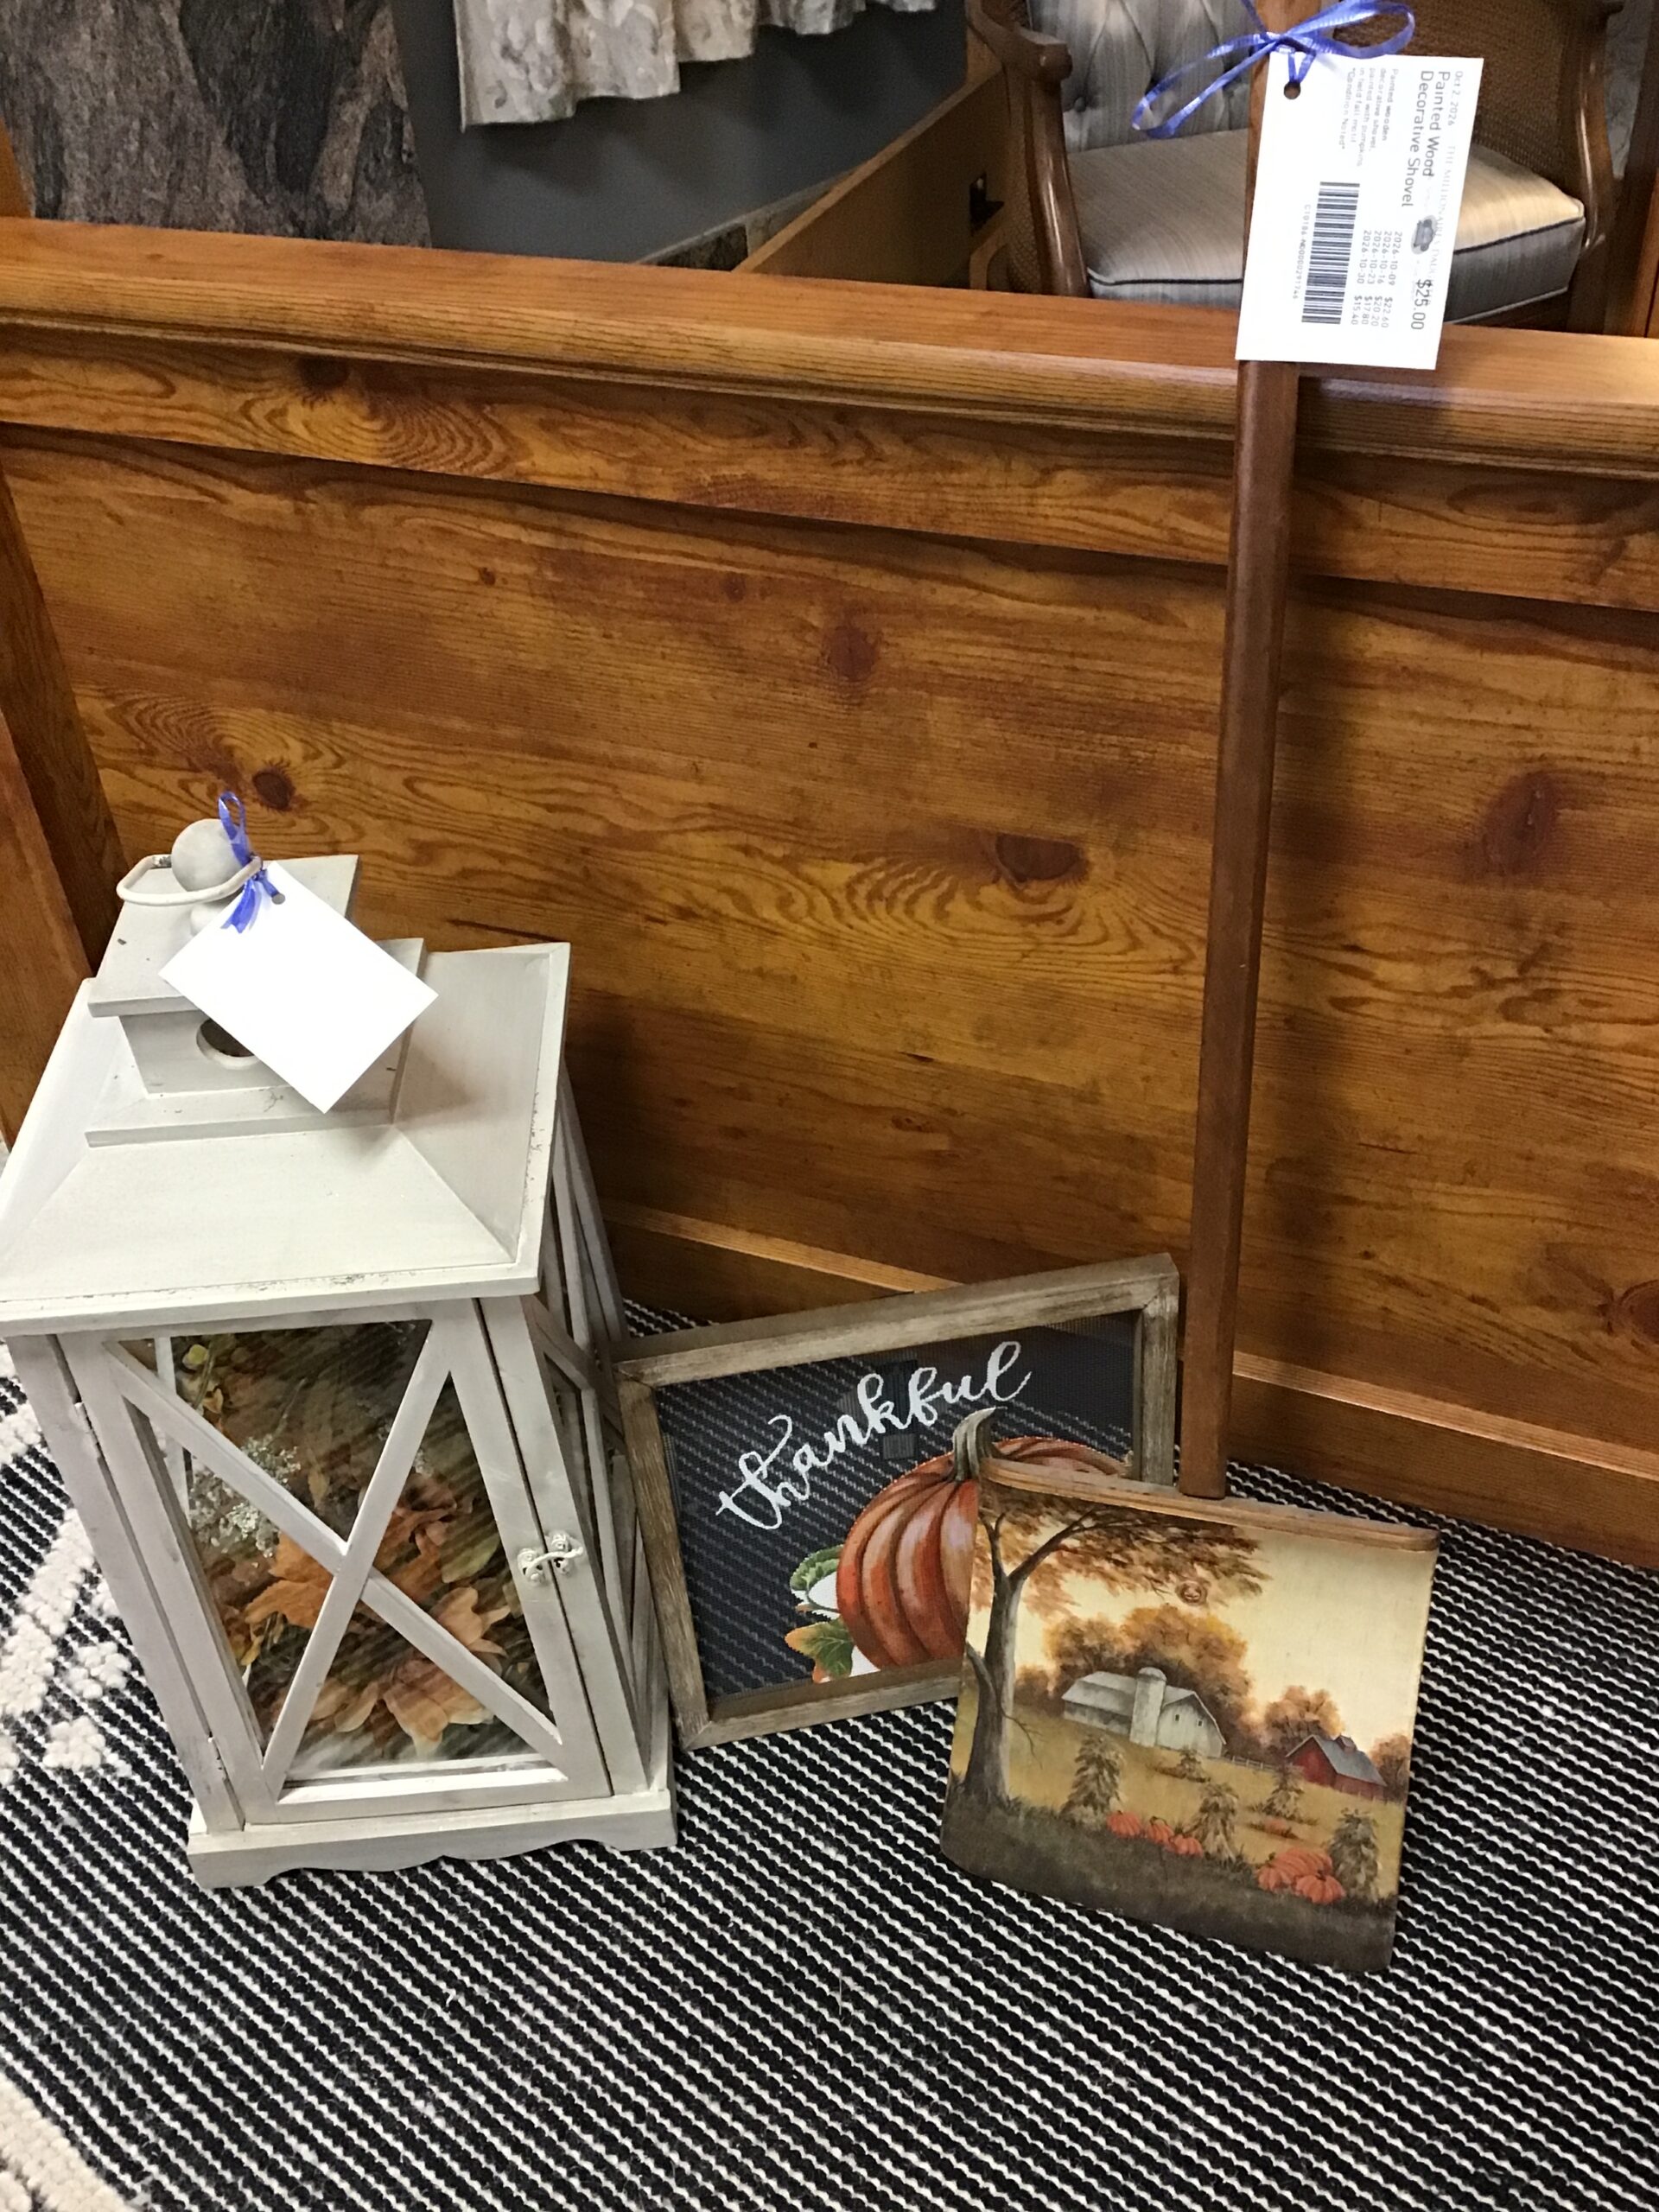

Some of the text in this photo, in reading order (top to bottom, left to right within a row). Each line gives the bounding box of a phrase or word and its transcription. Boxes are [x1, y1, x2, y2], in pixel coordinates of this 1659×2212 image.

[1366, 67, 1376, 101] painted
[1374, 68, 1387, 117] decorative
[1382, 68, 1399, 141] Painted wooden
[1429, 71, 1451, 130] Painted
[1453, 71, 1464, 87] Oct
[1409, 70, 1434, 153] Decorative
[1447, 101, 1459, 126] 2026
[1402, 157, 1421, 207] Shovel
[1422, 136, 1440, 177] Wood
[1351, 230, 1372, 325] 2026-10-30 $15.40
[1362, 230, 1382, 325] 2026-10-23 $17.80
[1370, 231, 1393, 327] 2026-10-16 $20.20
[1381, 231, 1402, 328] 2026-10-09 $22.60
[1410, 279, 1433, 330] $25.00
[715, 1341, 1032, 1529] thankful
